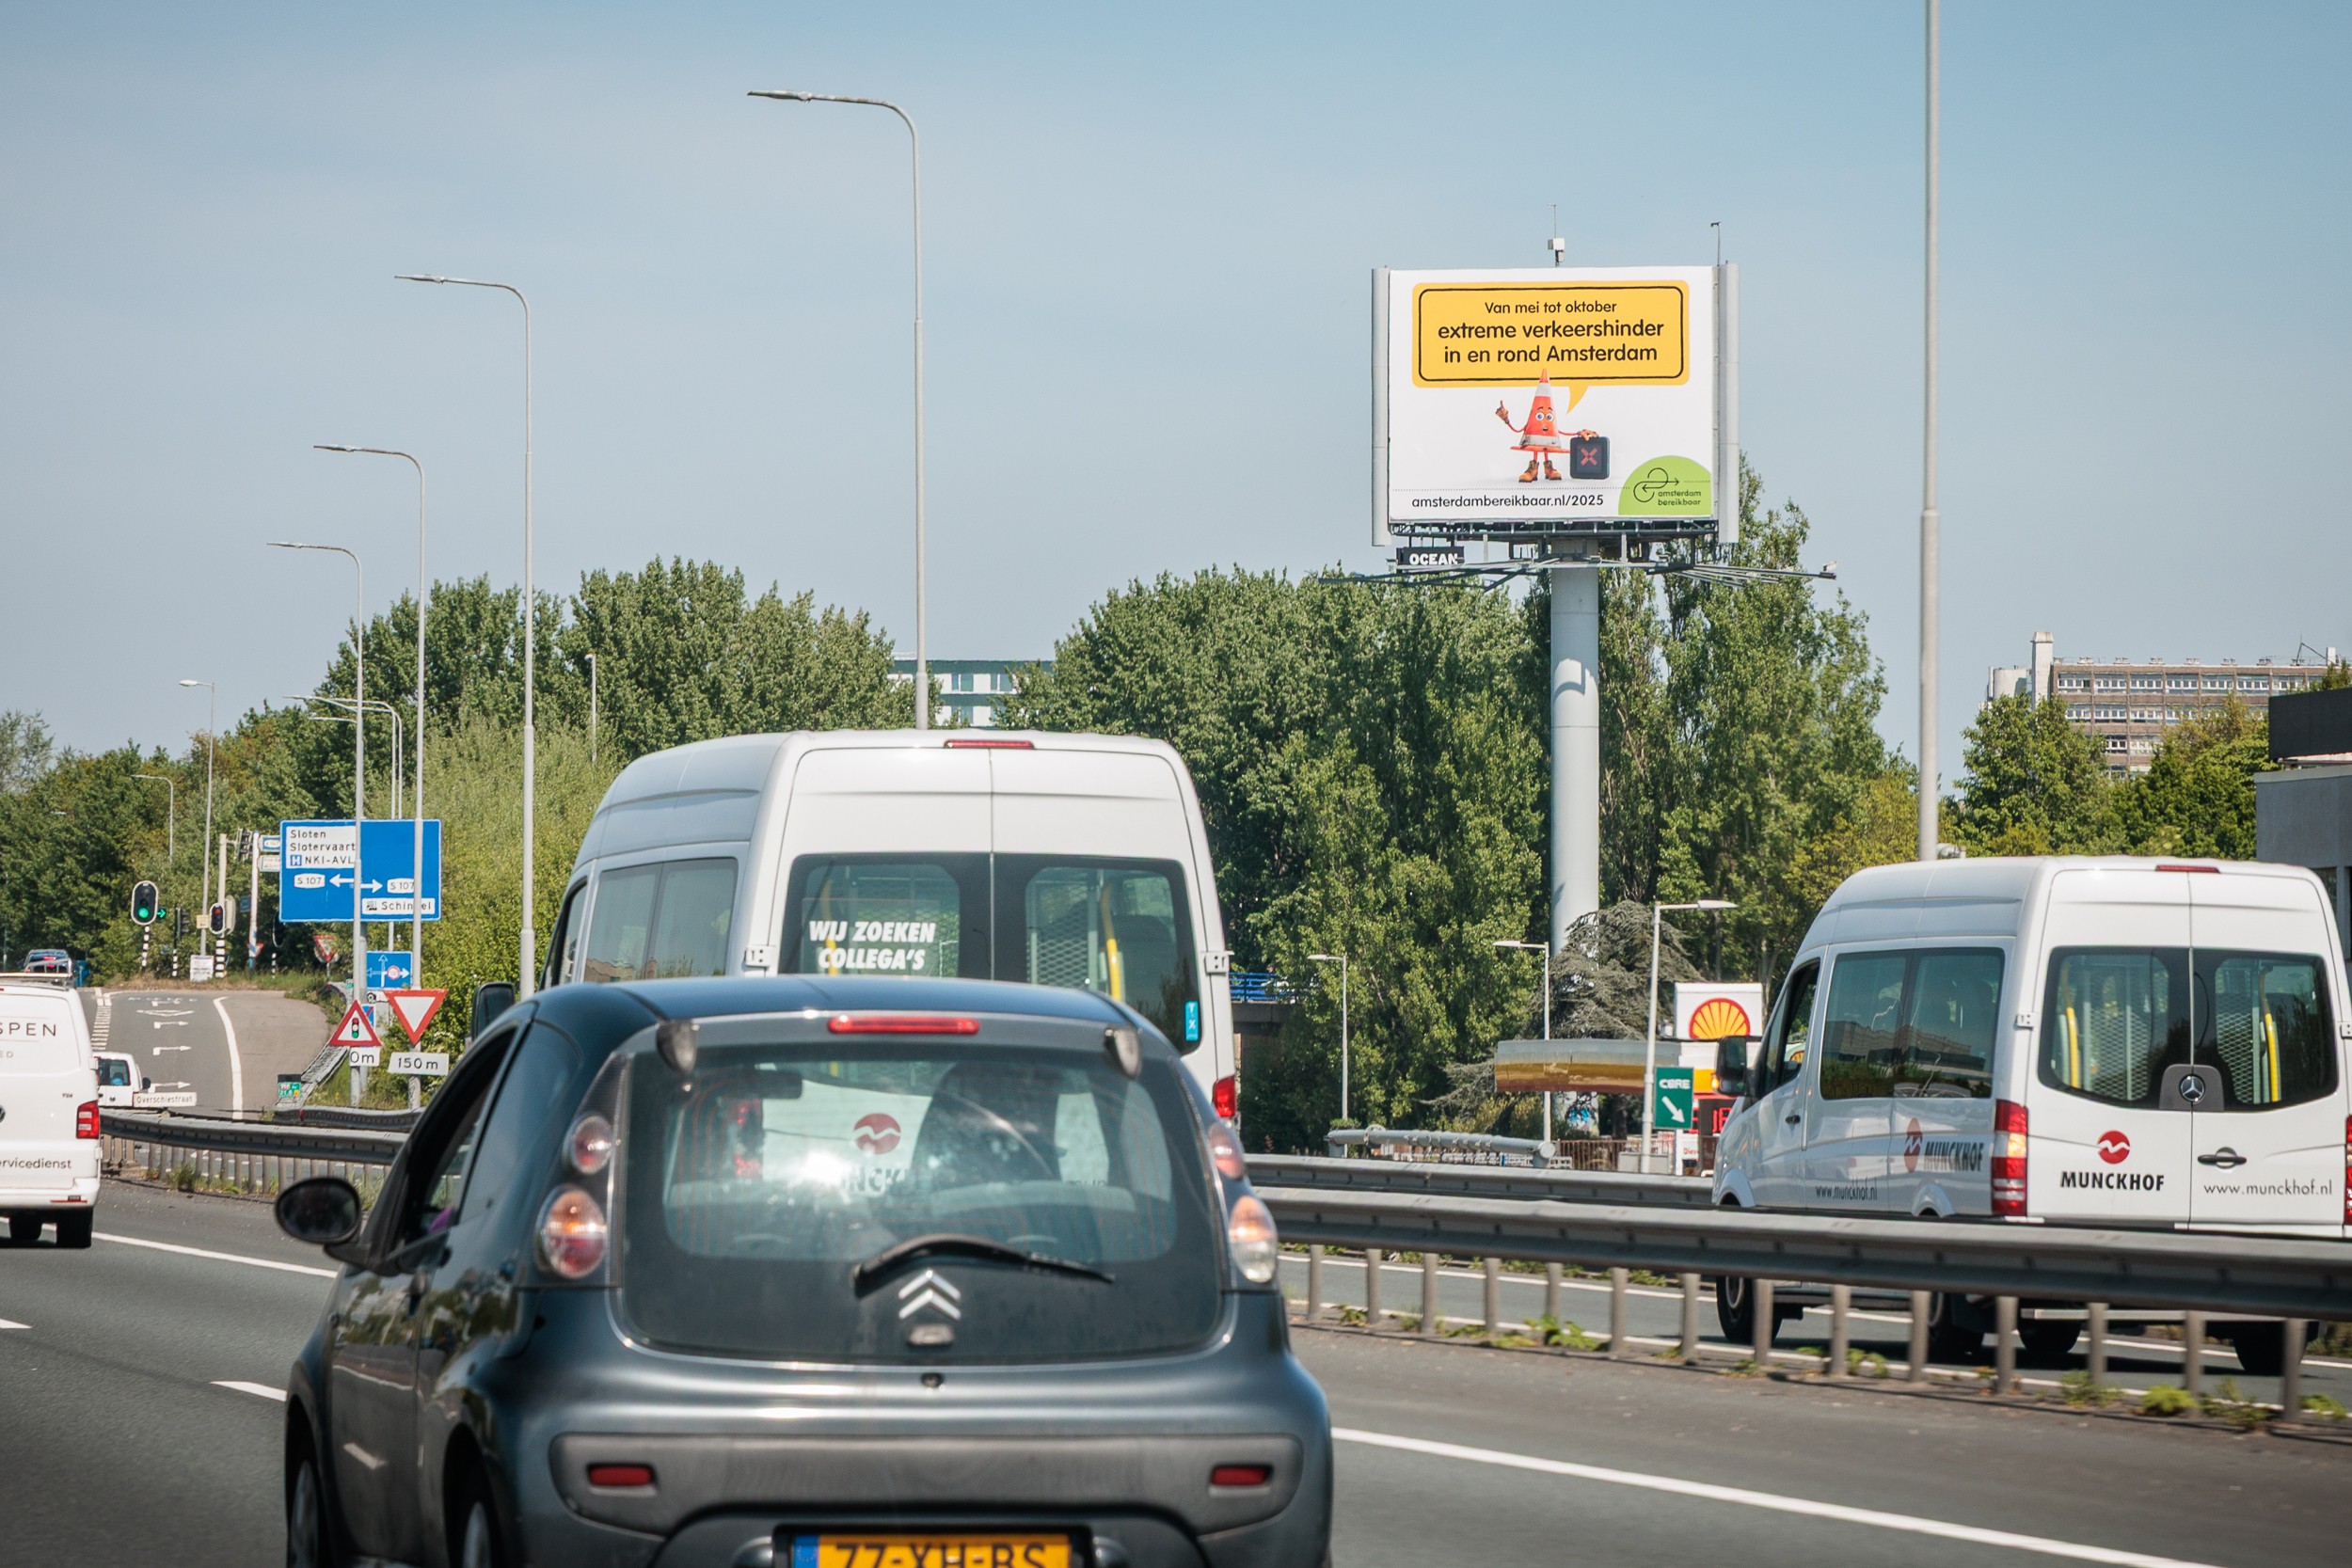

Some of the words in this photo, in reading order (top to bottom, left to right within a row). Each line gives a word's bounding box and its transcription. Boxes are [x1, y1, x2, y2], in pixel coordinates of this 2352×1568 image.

[1485, 301, 1511, 314] Van
[1515, 301, 1540, 314] mei
[1544, 301, 1562, 313] tot
[1565, 300, 1617, 313] oktober
[1438, 322, 1517, 339] extreme
[1522, 319, 1664, 339] verkeershinder
[1444, 345, 1461, 363] in
[1467, 348, 1490, 363] en
[1497, 345, 1540, 363] rond
[1546, 343, 1658, 362] Amsterdam
[1411, 494, 1604, 508] amsterdambereikbaar.nl/2025
[1657, 498, 1701, 506] bereikbaar
[1409, 552, 1459, 565] OCEAN
[290, 829, 326, 839] Sloten
[290, 843, 356, 852] Slotervaart
[305, 855, 355, 865] NKI-AVL
[306, 877, 323, 885] 107
[389, 882, 397, 891] S
[381, 901, 432, 911] Schinel
[809, 920, 849, 942] WIJ
[851, 921, 937, 943] ZOEKEN
[818, 946, 927, 971] COLLEGA'S
[0, 1022, 56, 1037] PEN
[398, 1057, 422, 1069] 150
[0, 1157, 72, 1169] rvicedienst
[1924, 1139, 1985, 1173] MUNCKHOF
[1816, 1176, 1879, 1201] www.munckhof.nl
[2059, 1171, 2165, 1192] MUNCKHOF
[2202, 1179, 2333, 1196] www.munckhof.nl
